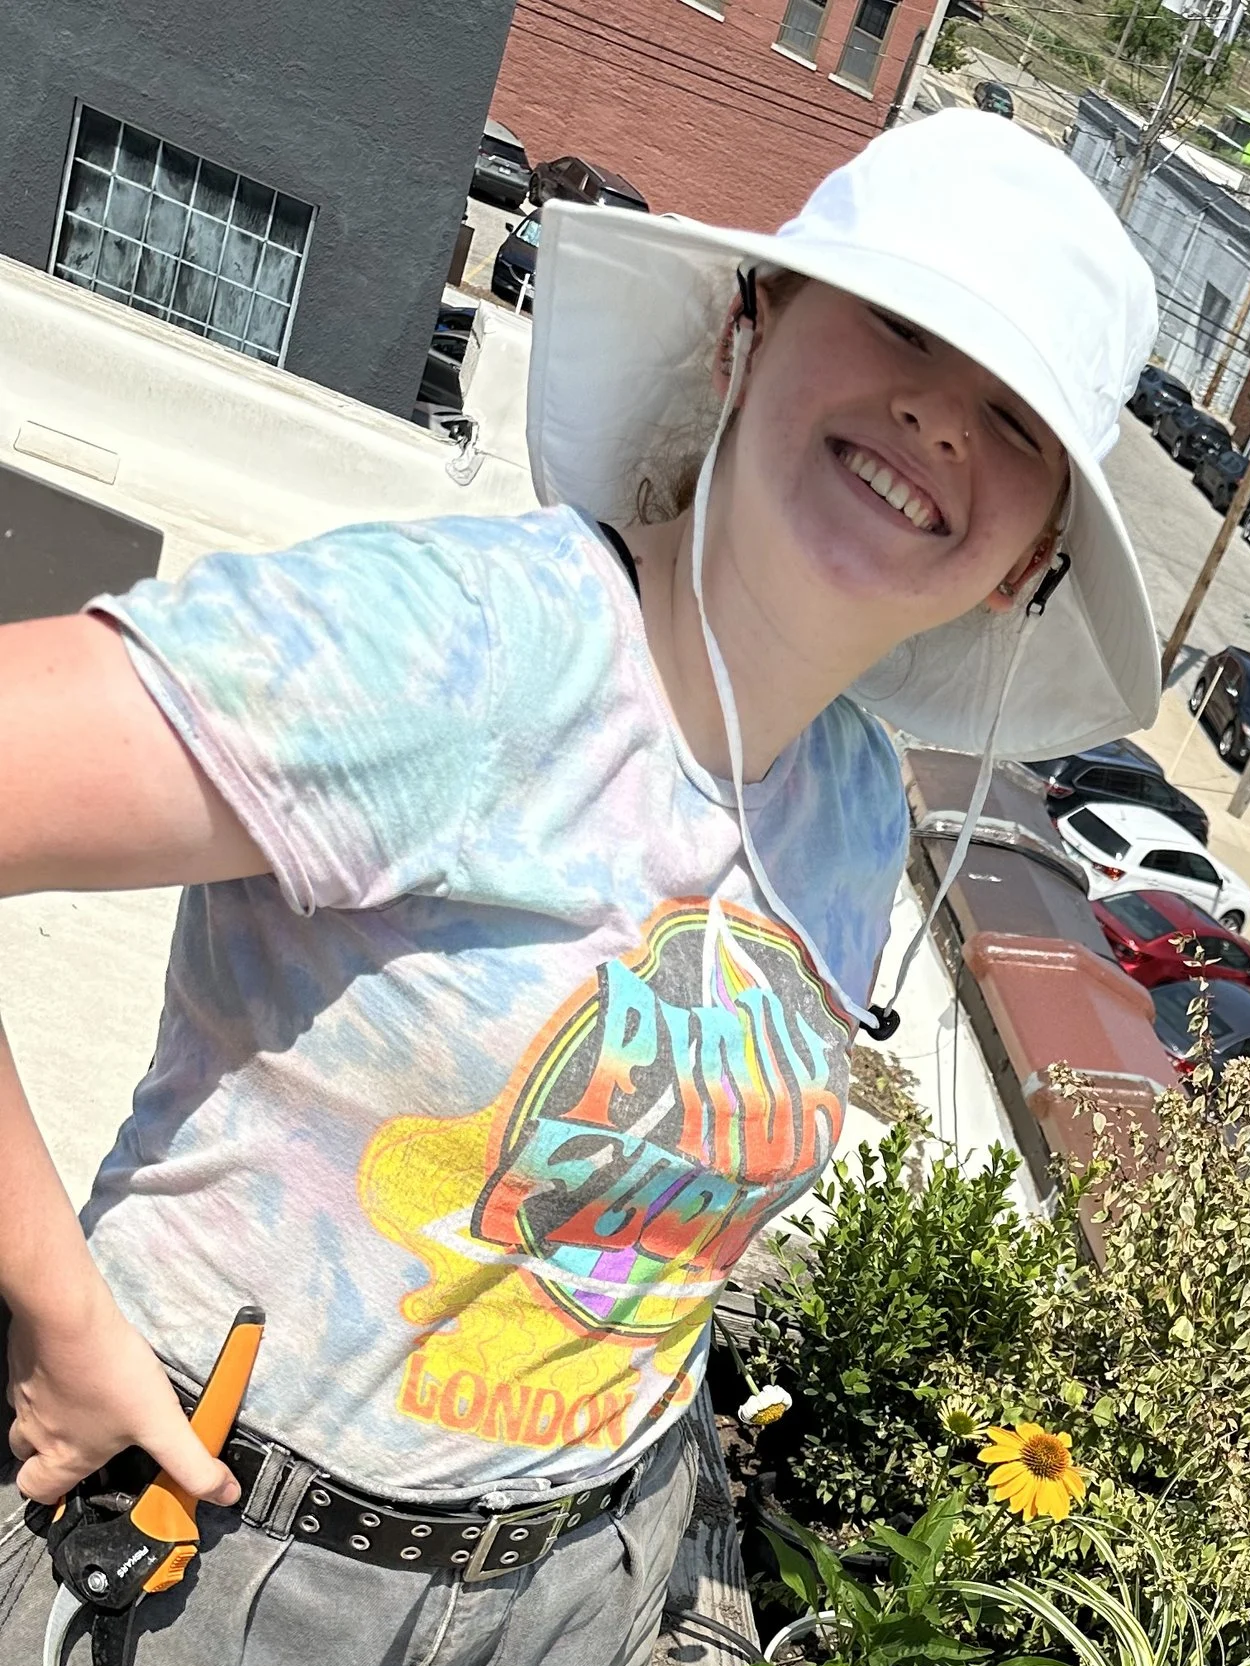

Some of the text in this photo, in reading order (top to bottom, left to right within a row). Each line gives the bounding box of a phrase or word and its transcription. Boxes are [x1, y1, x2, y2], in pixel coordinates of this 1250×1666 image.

[556, 959, 842, 1184] PINK
[400, 1352, 636, 1448] LONDON
[117, 1546, 149, 1578] FISKARS
